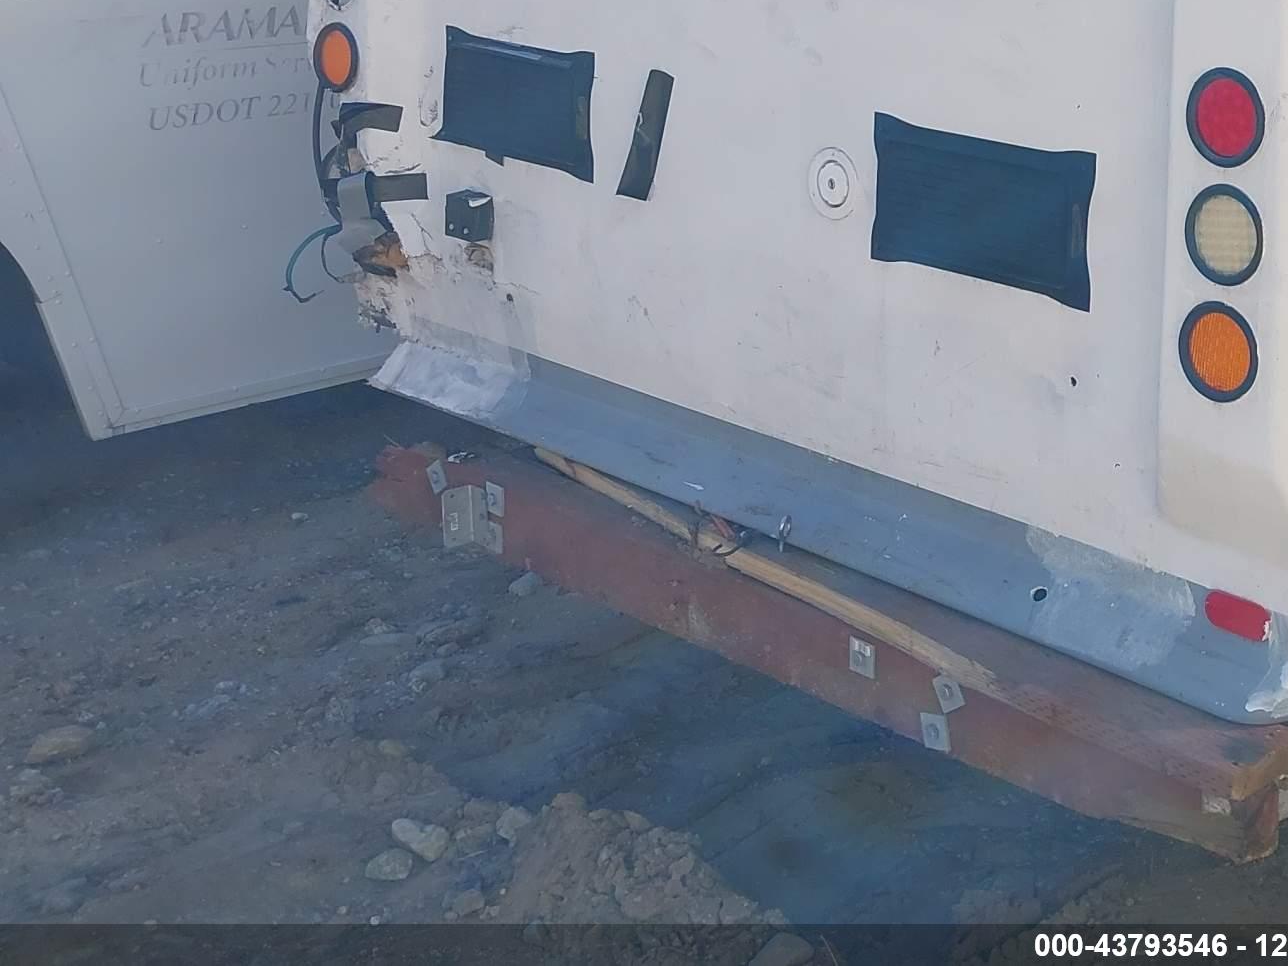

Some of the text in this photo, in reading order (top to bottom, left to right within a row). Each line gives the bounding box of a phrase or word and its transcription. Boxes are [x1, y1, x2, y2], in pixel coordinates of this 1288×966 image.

[141, 5, 308, 48] ARAMA
[139, 56, 256, 91] Uniform
[149, 96, 260, 131] USDOT
